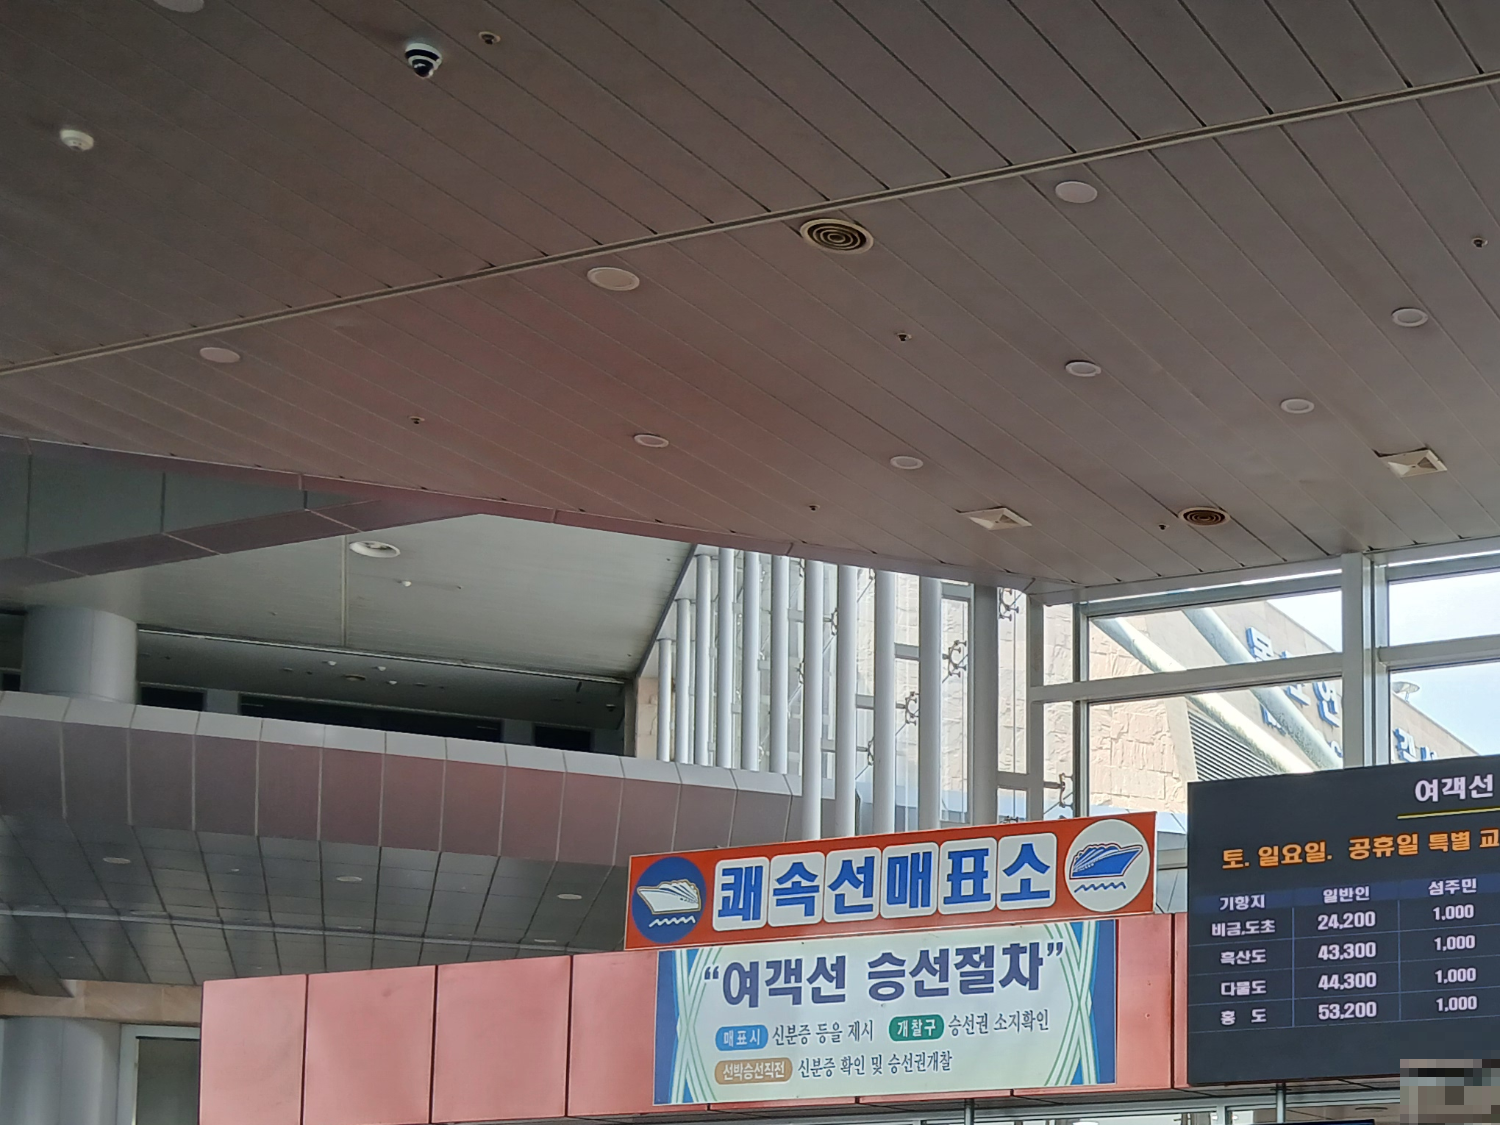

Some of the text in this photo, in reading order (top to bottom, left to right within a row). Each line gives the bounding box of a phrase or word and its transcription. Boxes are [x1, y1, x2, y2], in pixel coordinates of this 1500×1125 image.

[1414, 769, 1494, 802] 여객선
[1222, 847, 1249, 870] 토.
[1258, 840, 1333, 866] 일요일.
[1347, 834, 1418, 862] 공휴일
[1428, 829, 1470, 854] 특별
[718, 843, 1051, 921] 쾌속선매표소
[1219, 894, 1265, 911] 기항지
[1323, 885, 1370, 902] 일반인
[1428, 877, 1477, 895] 섬주민
[1317, 910, 1376, 931] 24,200
[1220, 947, 1266, 966] 흑산도
[1317, 941, 1376, 961] 43,300
[1434, 934, 1475, 952] 1,000
[1220, 978, 1266, 996] 다물도
[1318, 970, 1377, 992] 44,300
[1435, 967, 1476, 984] 1,000
[897, 1010, 1049, 1038] 개찰구 승선권 소지확인
[1317, 1000, 1377, 1022] 53,200
[1436, 995, 1477, 1013] 1,000
[722, 1023, 873, 1048] 매표시 신분증 등을 제시
[722, 1051, 952, 1082] 선박승선직전 신분증 확인 및 승선권개찰
